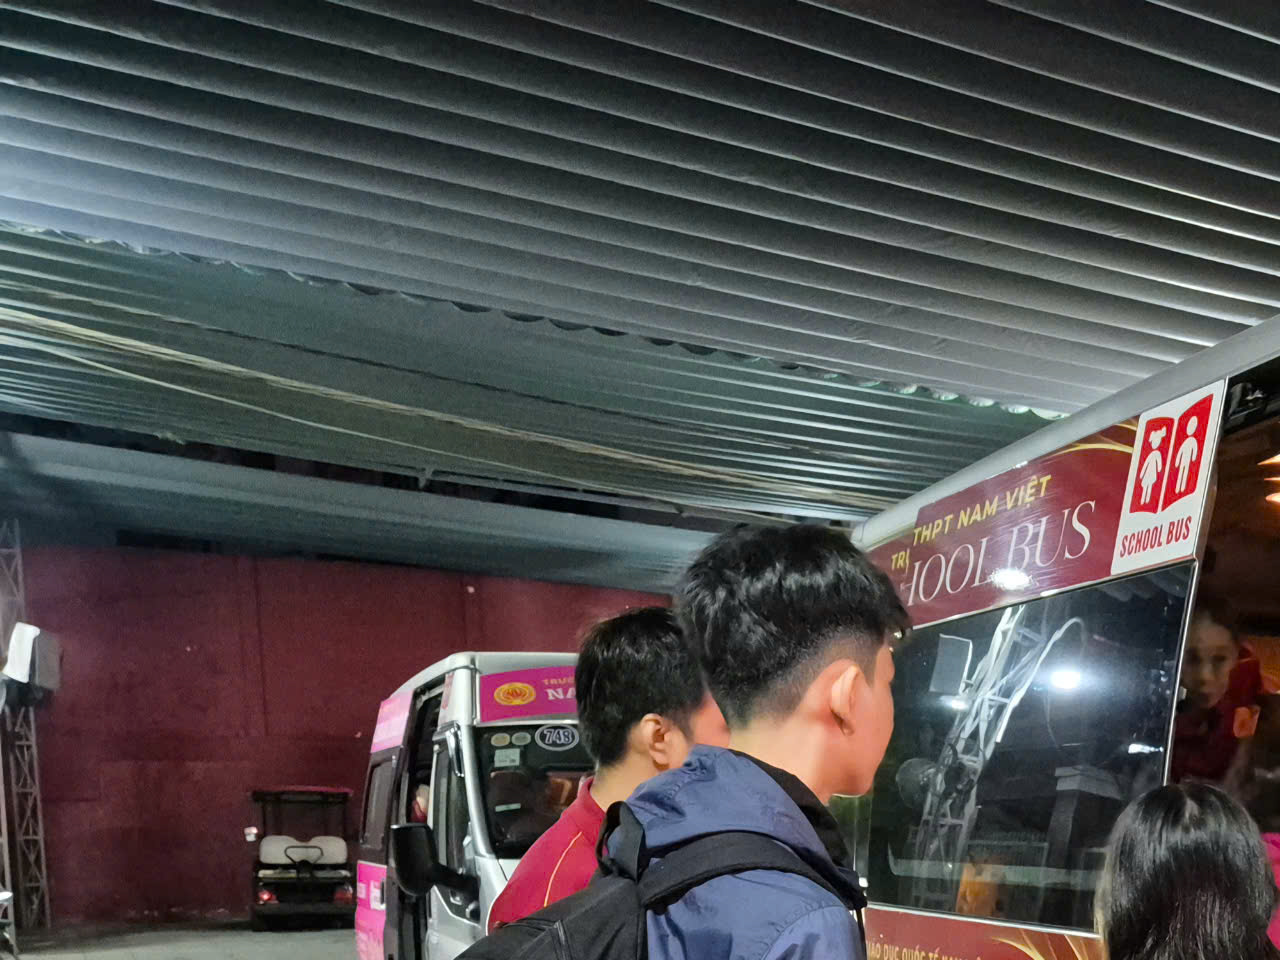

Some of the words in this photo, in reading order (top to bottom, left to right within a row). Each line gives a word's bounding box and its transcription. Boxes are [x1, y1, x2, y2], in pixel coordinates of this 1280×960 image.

[913, 515, 953, 546] THPT
[957, 496, 999, 529] NAM
[1006, 475, 1051, 508] VIỆT
[1007, 500, 1096, 575] BUS
[1120, 524, 1163, 557] SCHOOL
[1166, 516, 1192, 545] BUS
[543, 729, 572, 744] 748
